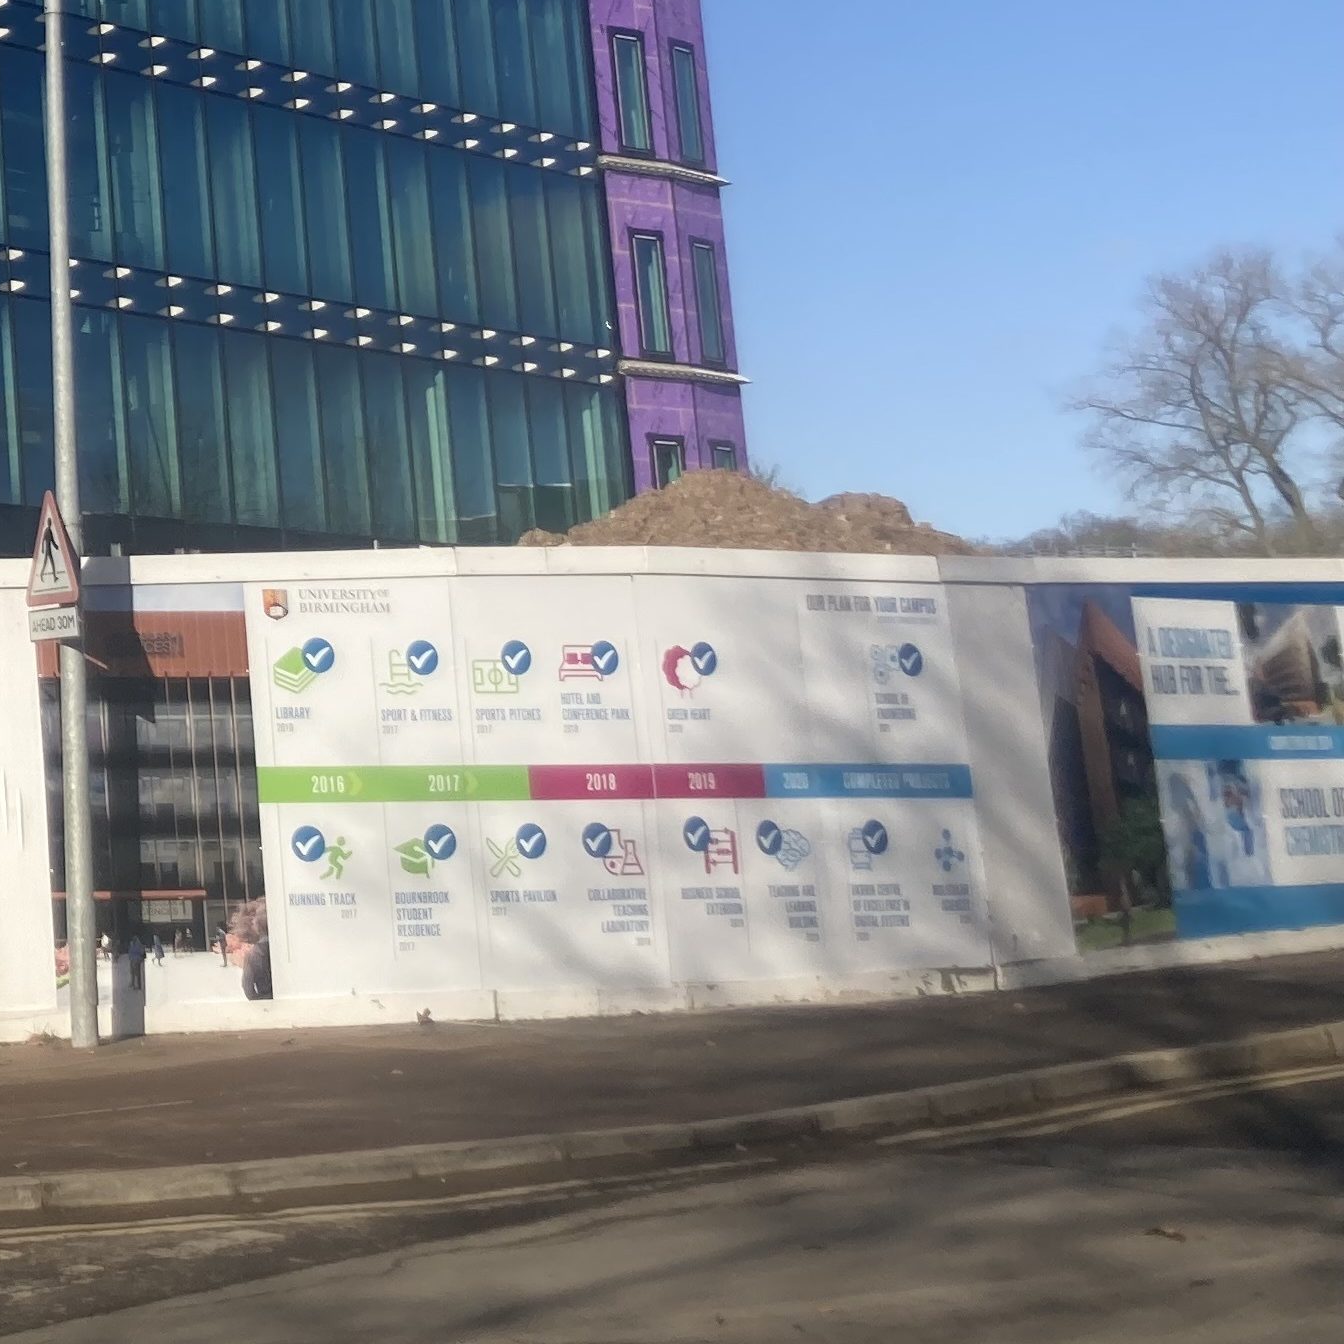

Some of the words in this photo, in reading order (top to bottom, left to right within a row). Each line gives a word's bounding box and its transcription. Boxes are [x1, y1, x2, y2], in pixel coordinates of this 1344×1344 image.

[298, 588, 375, 600] UNIVERSITY
[377, 588, 390, 597] OF
[299, 602, 391, 613] BIRMINGHAM
[32, 617, 56, 632] AHEAD
[57, 615, 76, 630] 30M
[560, 693, 585, 706] HOTEL
[275, 706, 311, 720] LIBRARY
[381, 708, 407, 722] SPORT
[410, 709, 417, 722] &
[419, 708, 453, 721] FITNESS
[475, 708, 506, 721] SPORTS
[509, 708, 542, 720] PITCHES
[561, 707, 610, 721] CONFERENCE
[311, 775, 344, 793] 2016
[428, 774, 460, 792] 2017
[586, 773, 617, 791] 2018
[688, 772, 716, 790] 2019
[1279, 788, 1330, 818] SCHOOL
[288, 892, 326, 906] RUNNING
[328, 892, 357, 905] TRACK
[395, 891, 450, 905] BOURNBROOK
[396, 907, 433, 921] STUDENT
[397, 923, 442, 937] RESIDENCE
